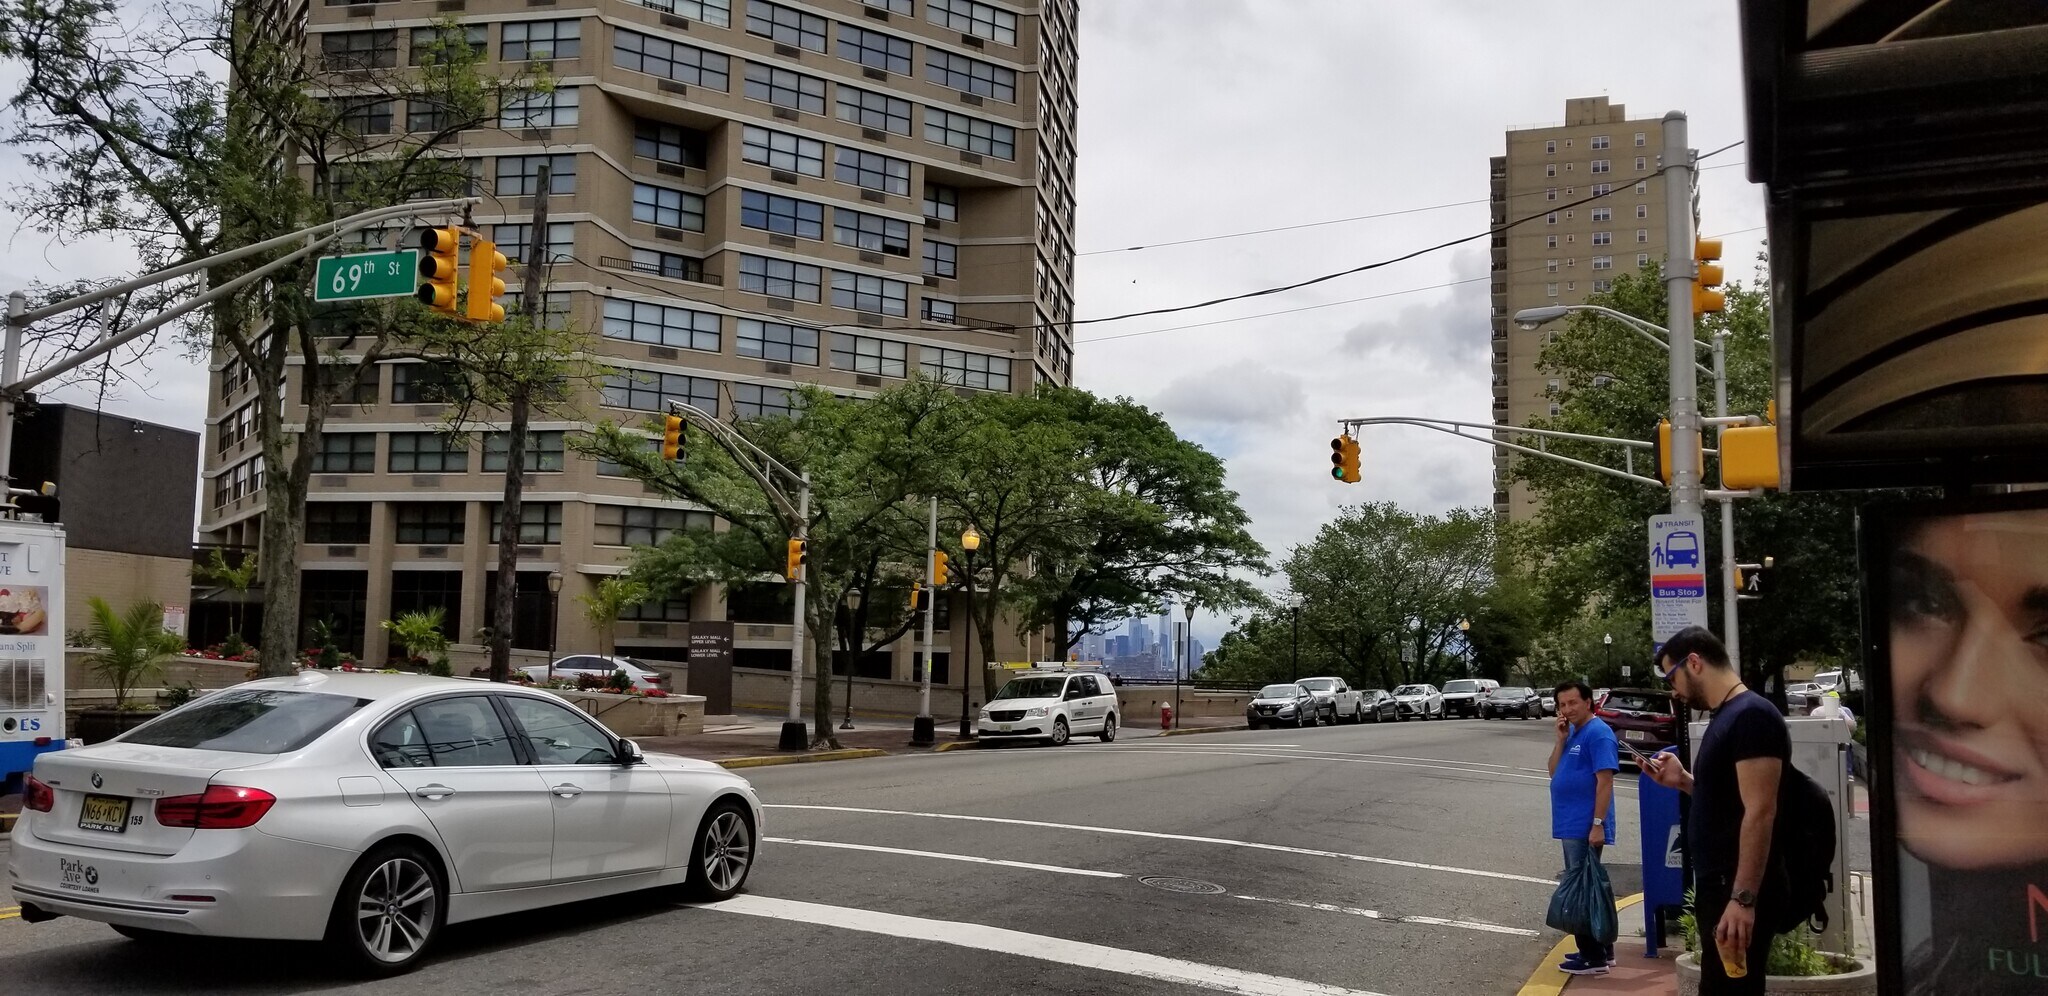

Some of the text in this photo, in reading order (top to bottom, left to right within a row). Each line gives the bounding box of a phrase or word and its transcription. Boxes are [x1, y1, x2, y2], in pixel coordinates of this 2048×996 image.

[332, 260, 400, 294] 69th St
[1677, 589, 1698, 597] Stop
[17, 641, 36, 652] Split
[130, 816, 144, 826] 159
[60, 857, 84, 873] Park
[62, 868, 81, 884] Ave
[60, 882, 82, 890] COURTESY
